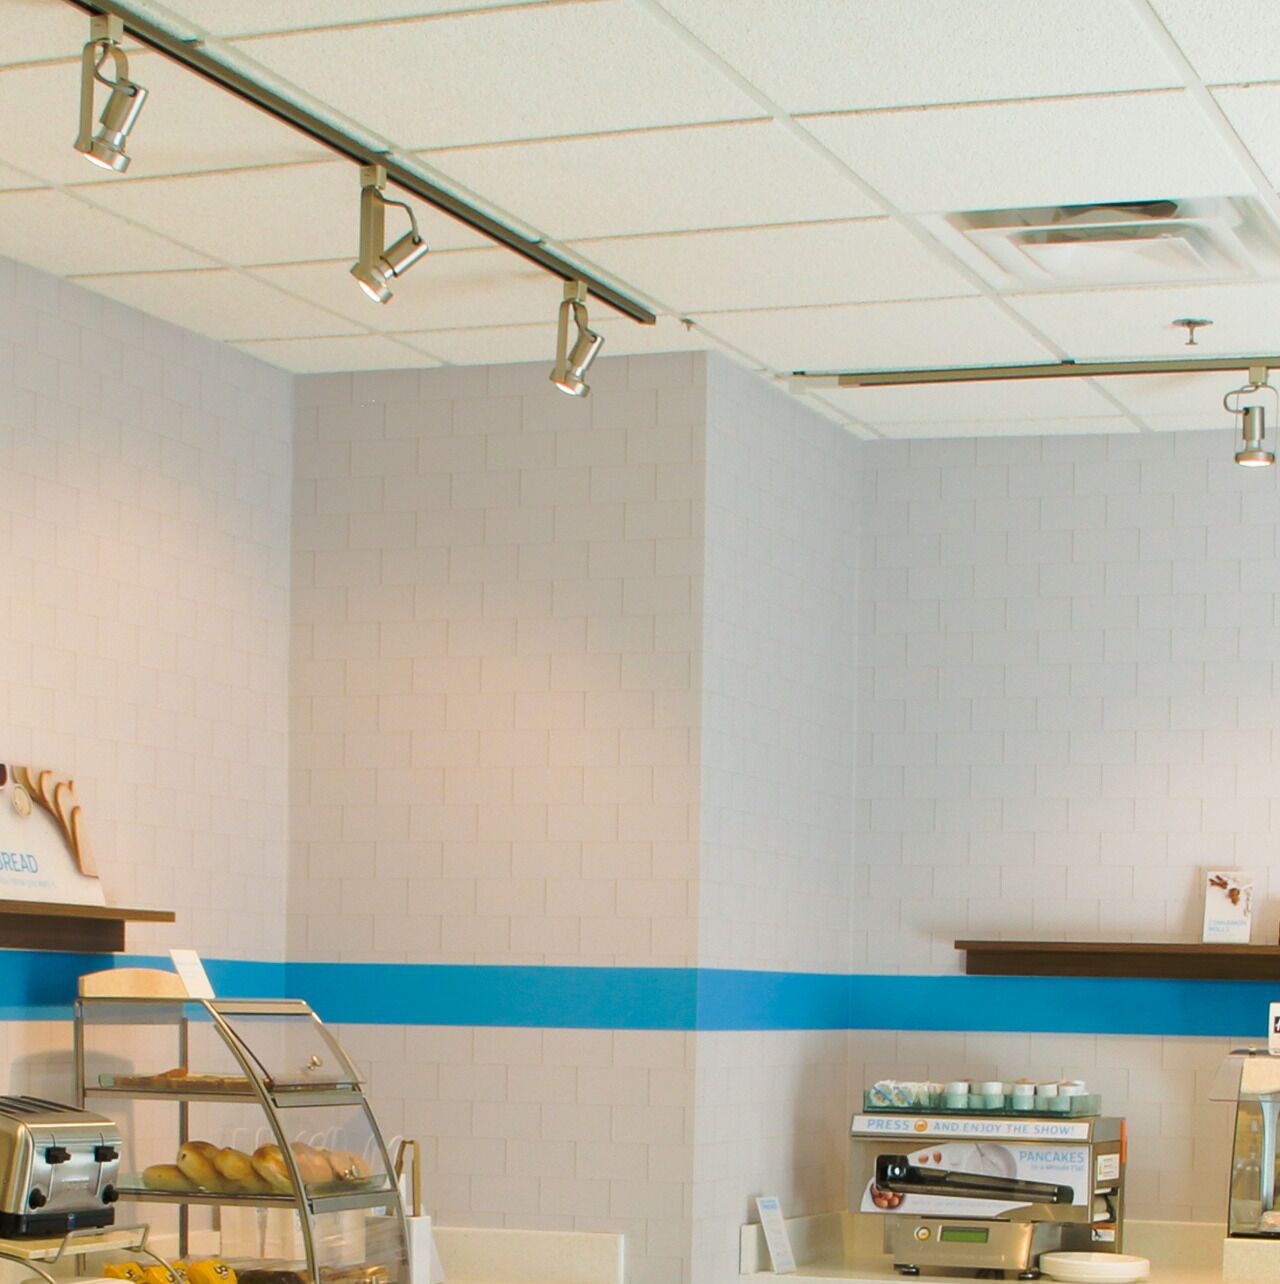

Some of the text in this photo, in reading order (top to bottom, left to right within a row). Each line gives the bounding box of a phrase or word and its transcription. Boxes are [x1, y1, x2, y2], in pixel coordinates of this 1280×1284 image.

[867, 1119, 910, 1130] PRESS
[934, 1122, 959, 1132] AND
[963, 1123, 1002, 1133] ENJOY
[1007, 1124, 1029, 1134] THE
[1034, 1125, 1074, 1136] SHOW!
[1019, 1150, 1084, 1163] PANCAKES
